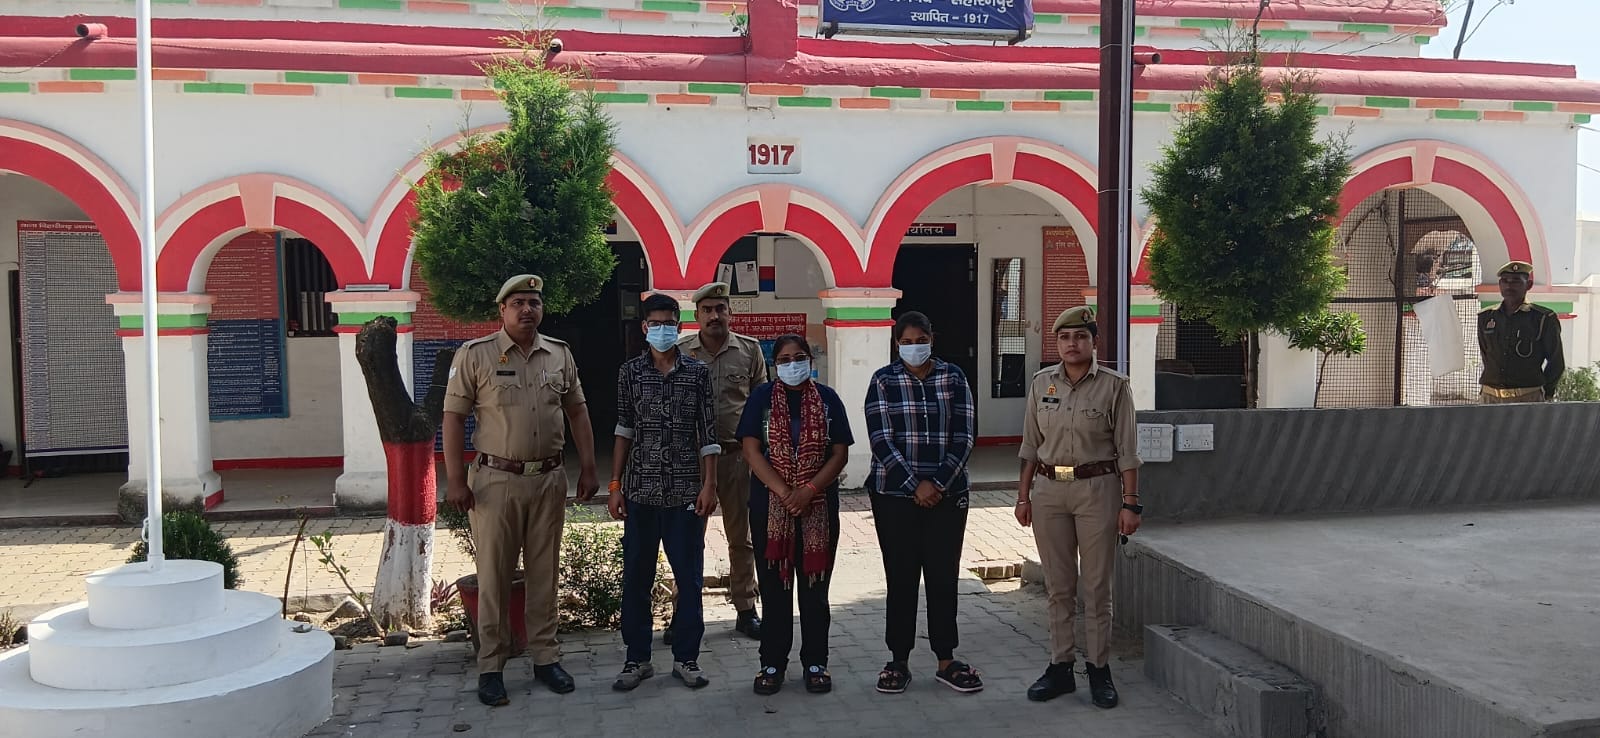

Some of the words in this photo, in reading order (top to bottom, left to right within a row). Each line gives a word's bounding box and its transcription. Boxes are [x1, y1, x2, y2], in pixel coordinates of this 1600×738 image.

[911, 9, 949, 23] स्थापित
[963, 13, 989, 24] 1917
[748, 143, 795, 166] 1917
